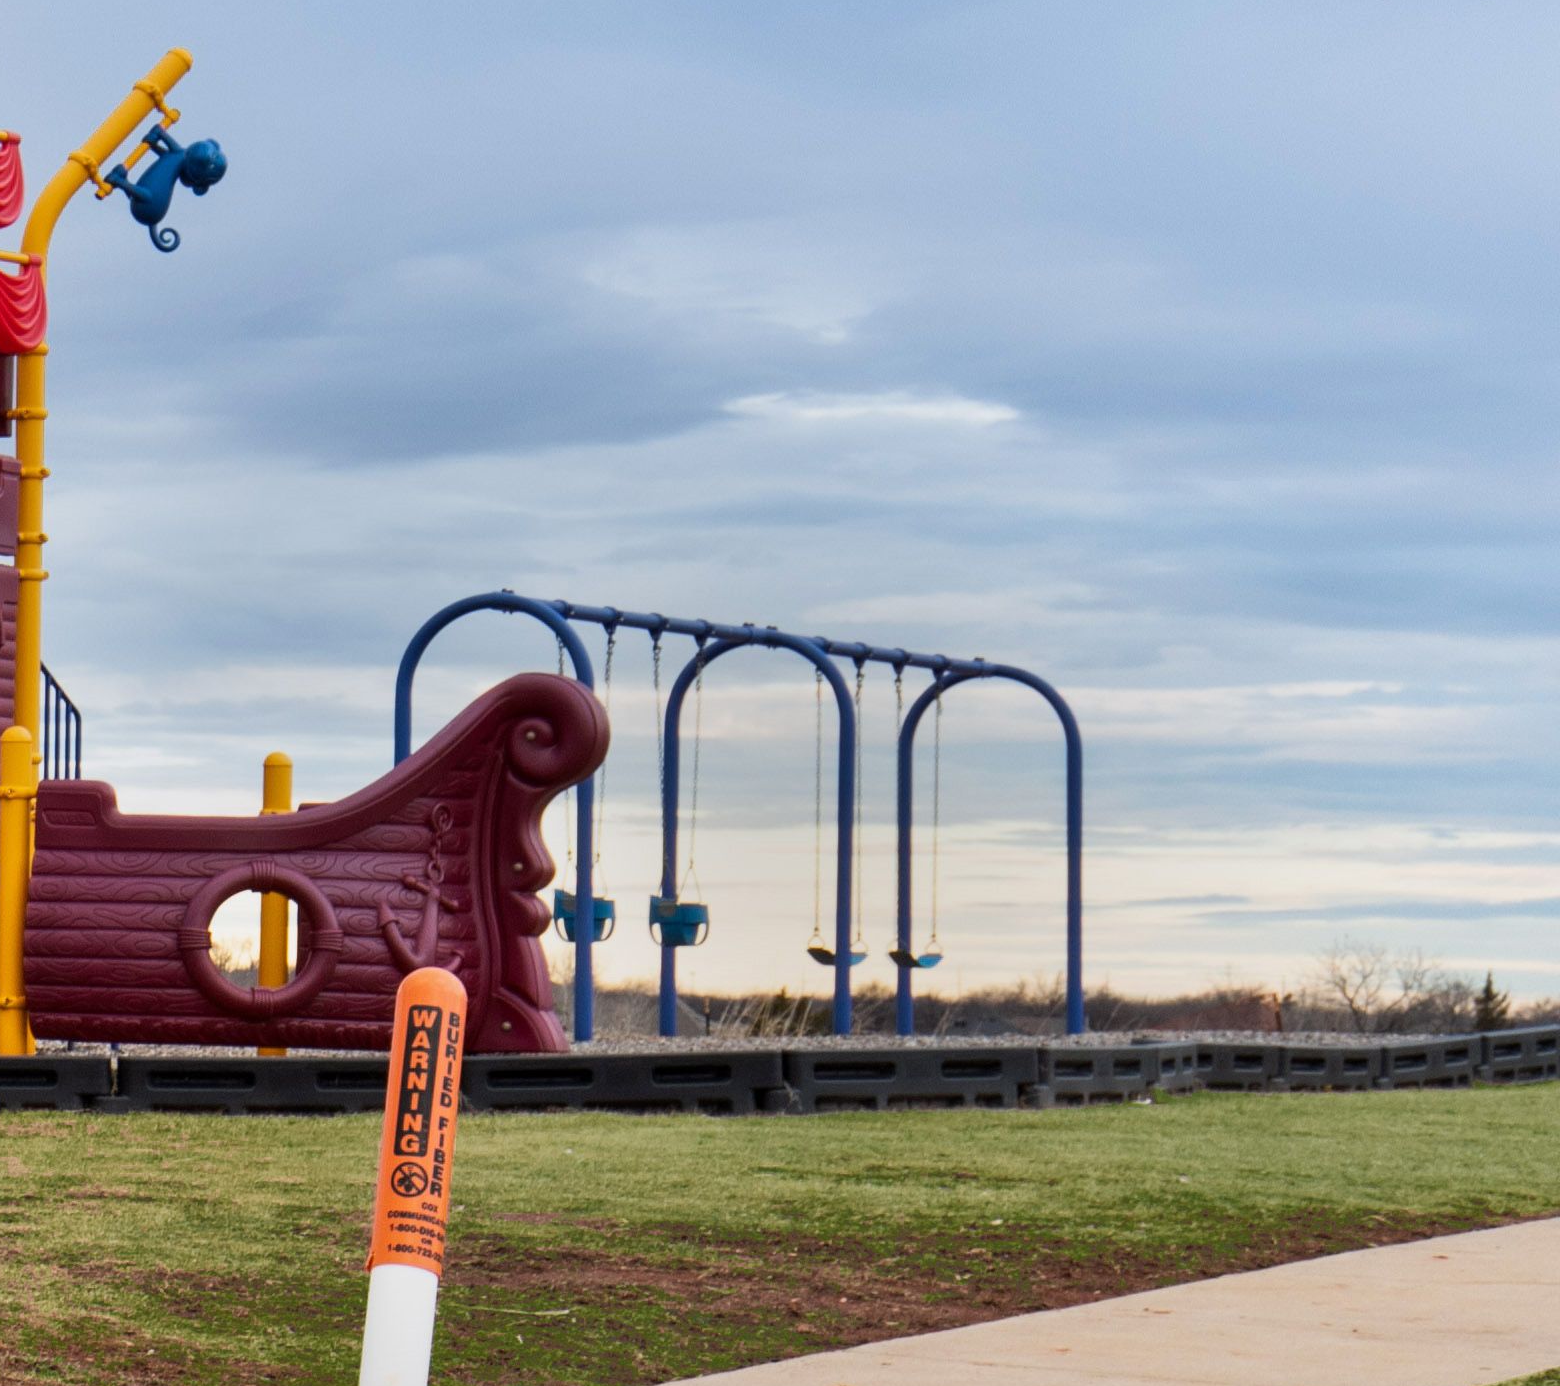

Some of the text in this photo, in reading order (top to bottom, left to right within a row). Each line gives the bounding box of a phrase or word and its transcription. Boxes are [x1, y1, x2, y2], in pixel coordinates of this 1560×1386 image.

[400, 1009, 438, 1153] WARNING
[429, 1012, 460, 1198] BURIED FIBER
